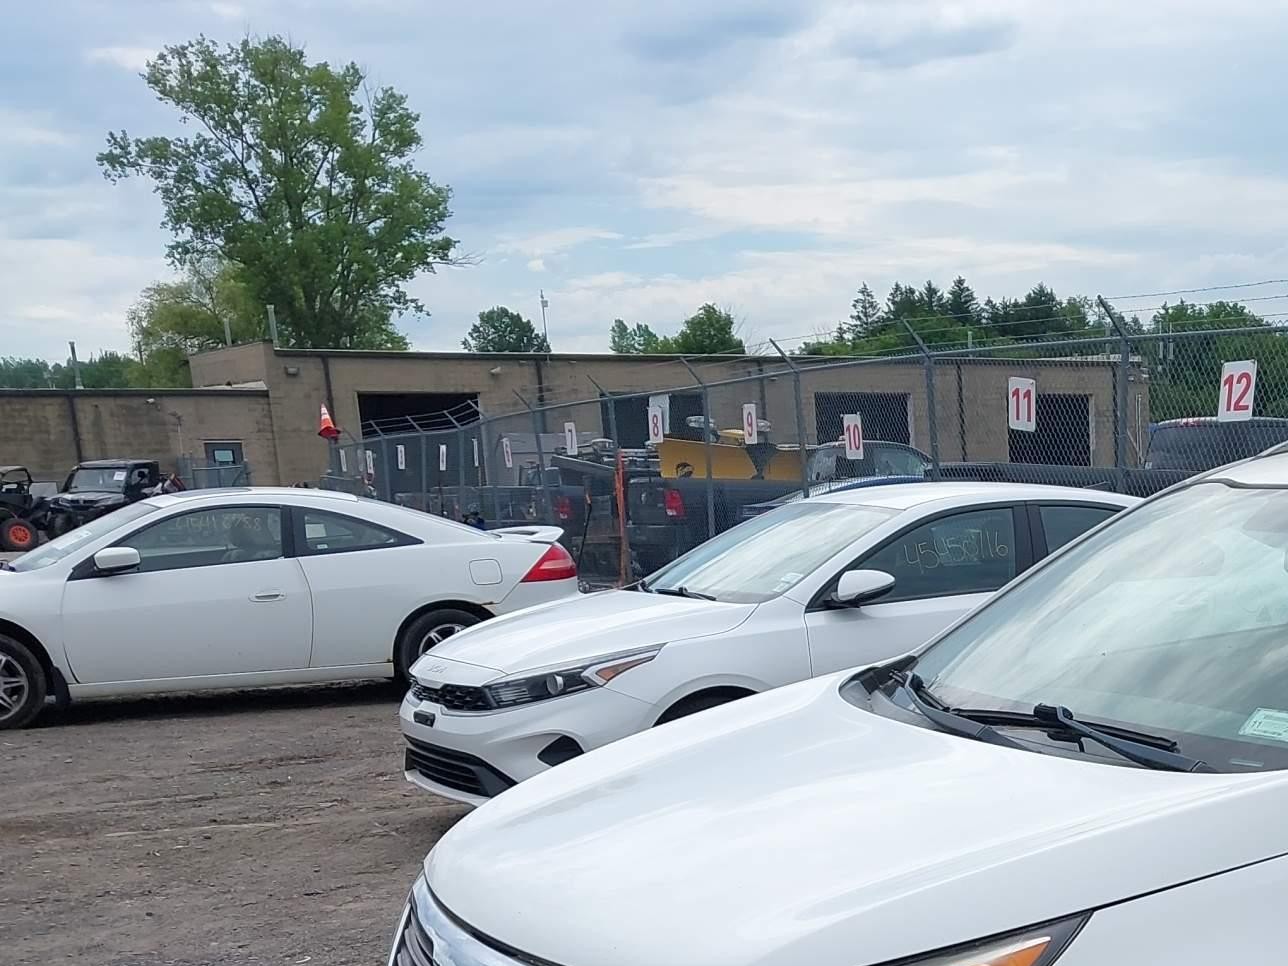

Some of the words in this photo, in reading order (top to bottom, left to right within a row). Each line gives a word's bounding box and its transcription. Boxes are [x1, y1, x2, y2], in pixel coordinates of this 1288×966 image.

[1011, 387, 1033, 423] 11
[1223, 372, 1252, 412] 12
[651, 414, 660, 437] 8
[746, 412, 754, 437] 9
[845, 423, 861, 450] 10
